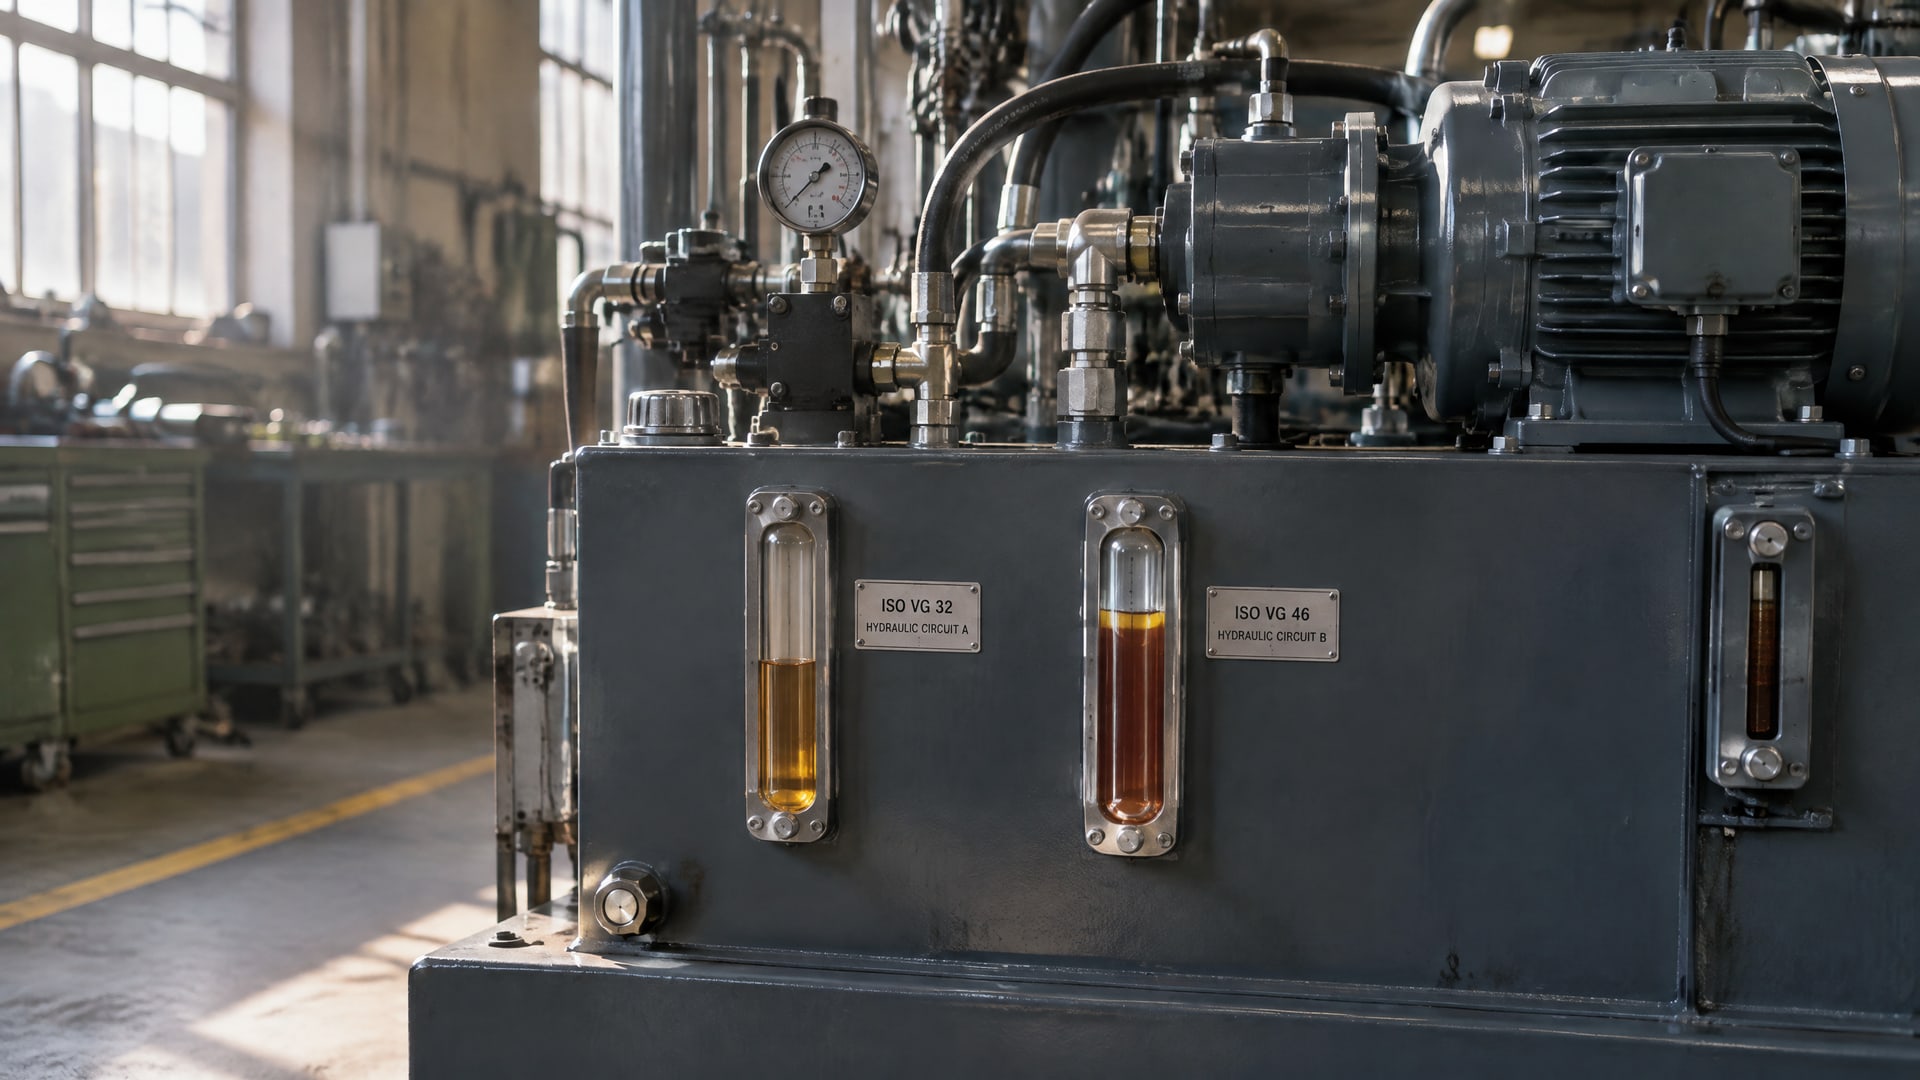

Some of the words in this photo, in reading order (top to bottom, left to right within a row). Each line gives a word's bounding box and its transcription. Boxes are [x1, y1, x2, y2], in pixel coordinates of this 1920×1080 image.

[882, 598, 906, 613] ISO
[910, 599, 930, 613] VG
[935, 600, 953, 614] 32
[1235, 605, 1260, 620] ISO
[1265, 606, 1286, 620] VG
[1291, 607, 1310, 621] 46
[866, 622, 918, 633] HYDRAULIC
[921, 623, 959, 634] CIRCUIT
[961, 624, 969, 634] A
[1217, 630, 1273, 641] HYDRAULIC
[1276, 631, 1316, 642] CIRCUIT
[1319, 632, 1327, 642] B
